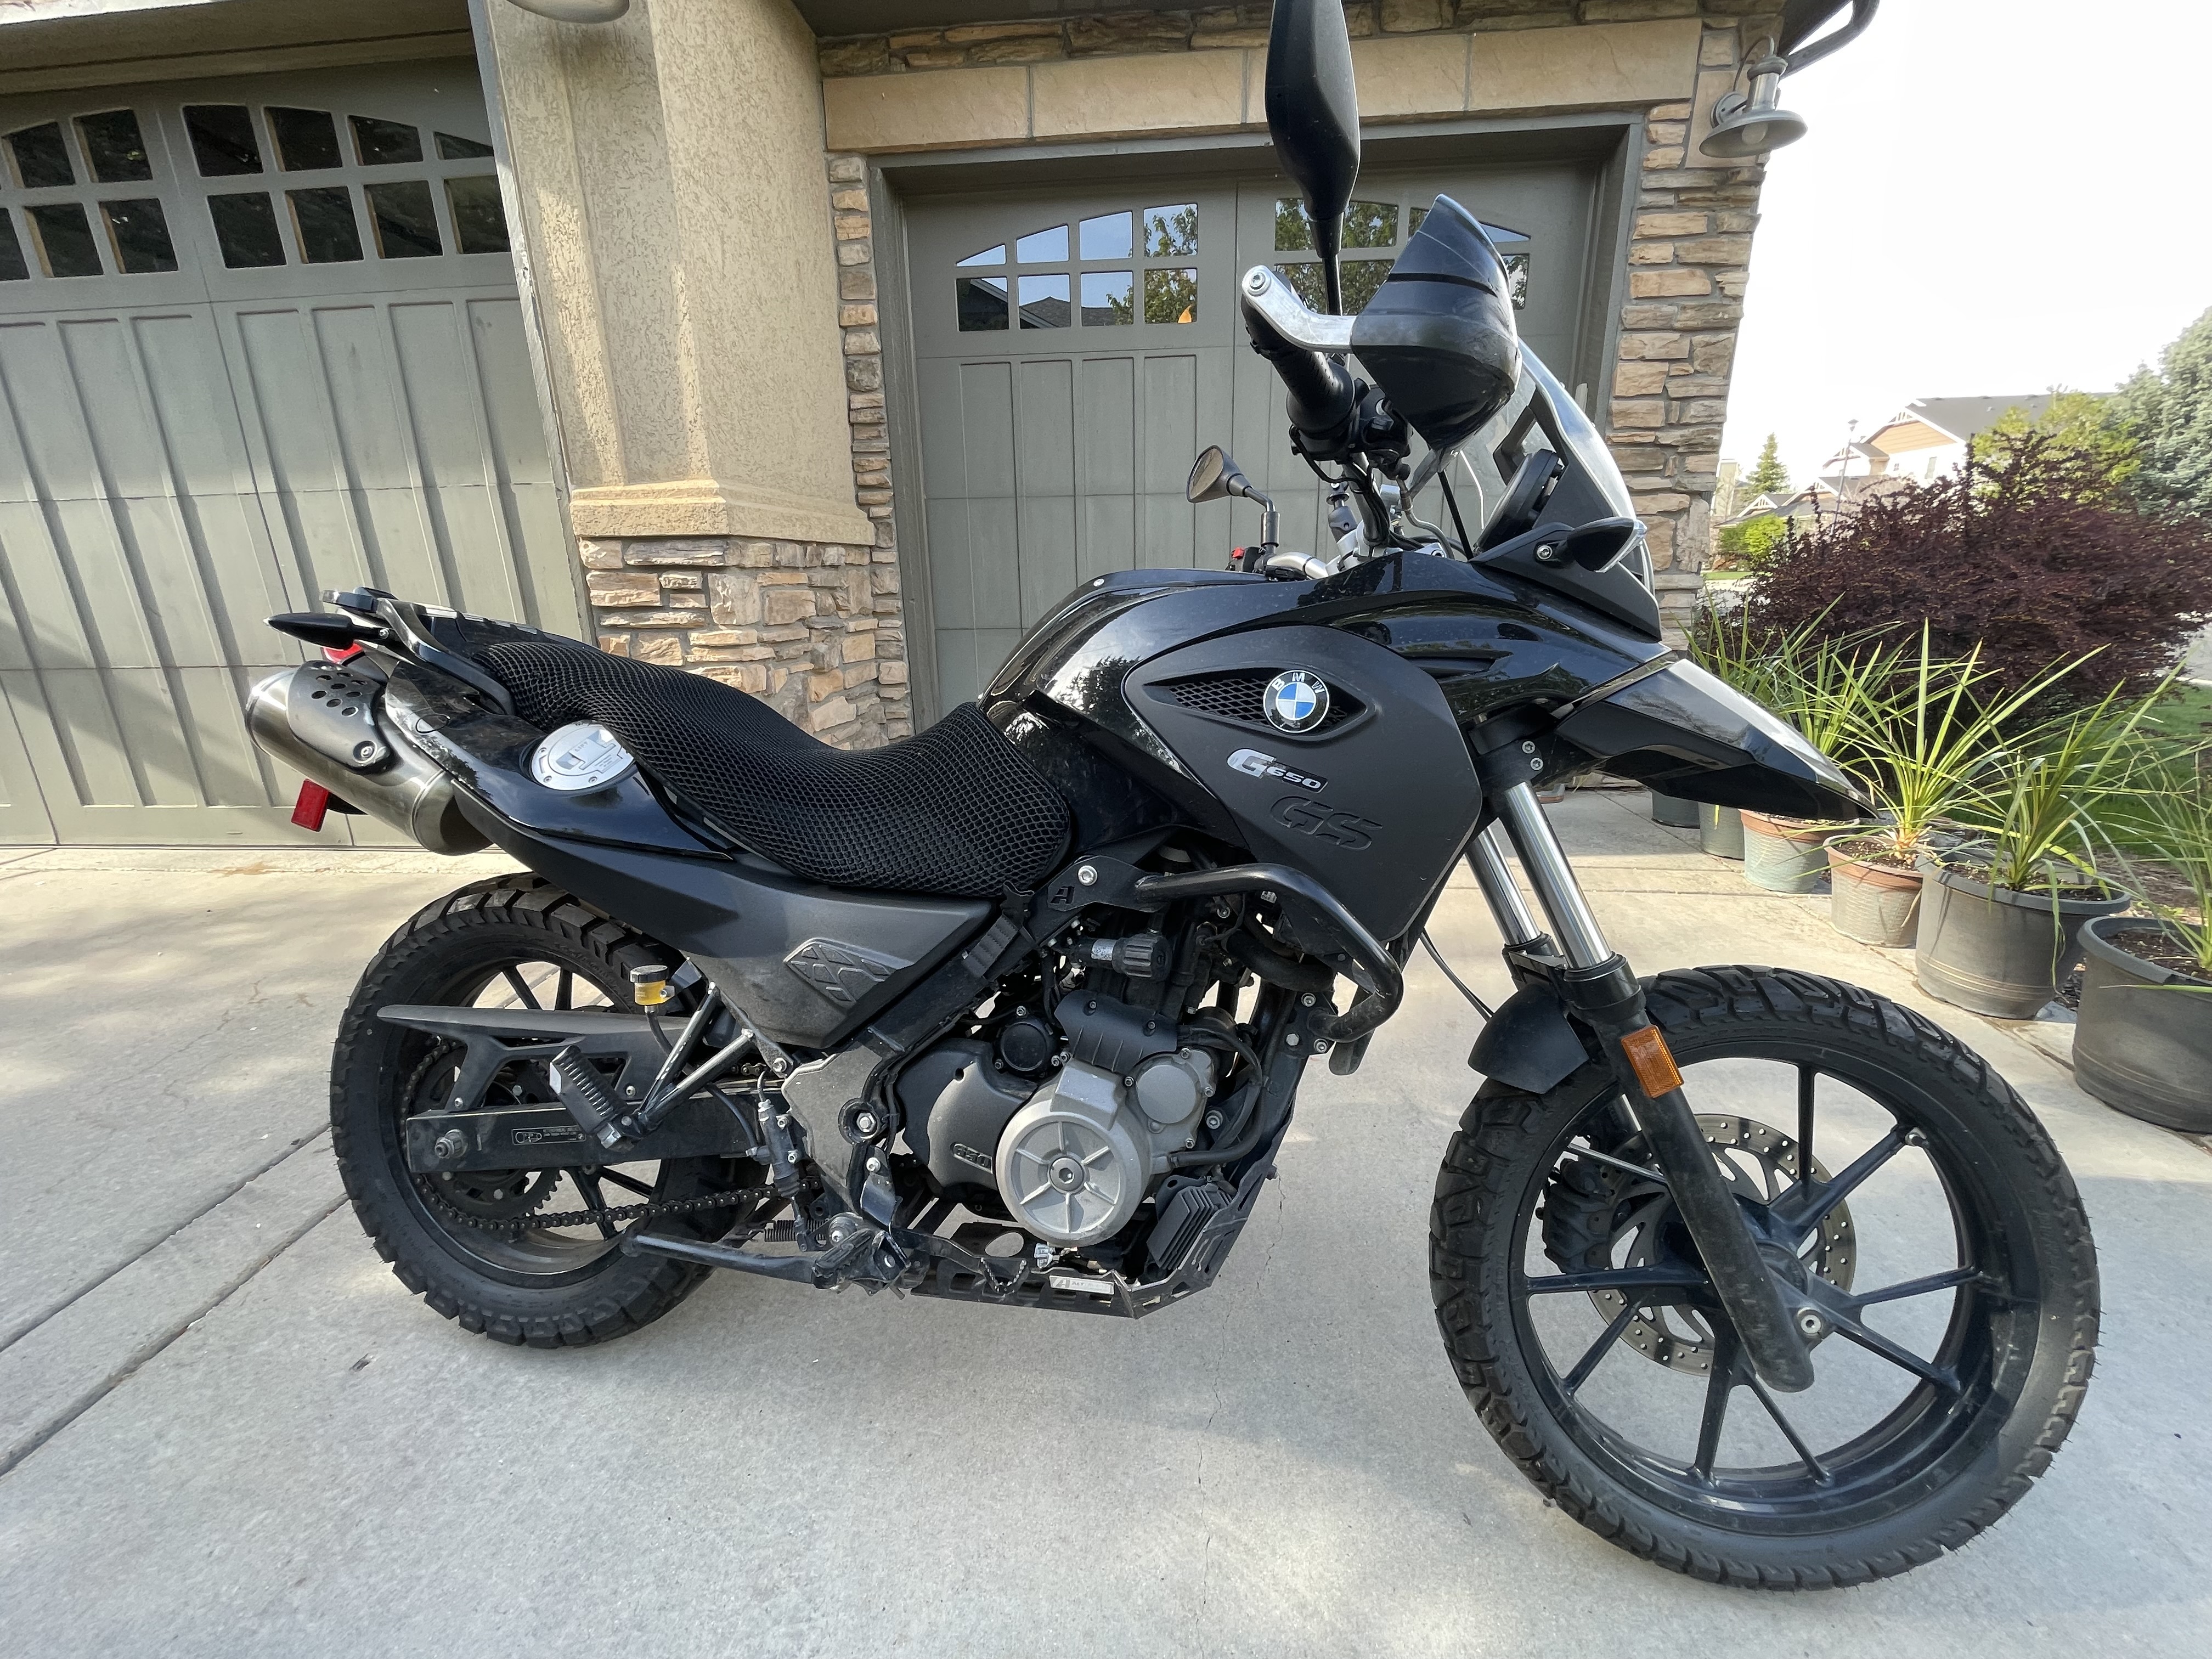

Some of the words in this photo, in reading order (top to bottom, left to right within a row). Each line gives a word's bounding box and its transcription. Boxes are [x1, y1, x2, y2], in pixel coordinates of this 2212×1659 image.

[1272, 672, 1325, 694] BMW
[574, 741, 588, 752] LIFT
[1271, 796, 1383, 851] GS
[954, 1146, 990, 1168] 650
